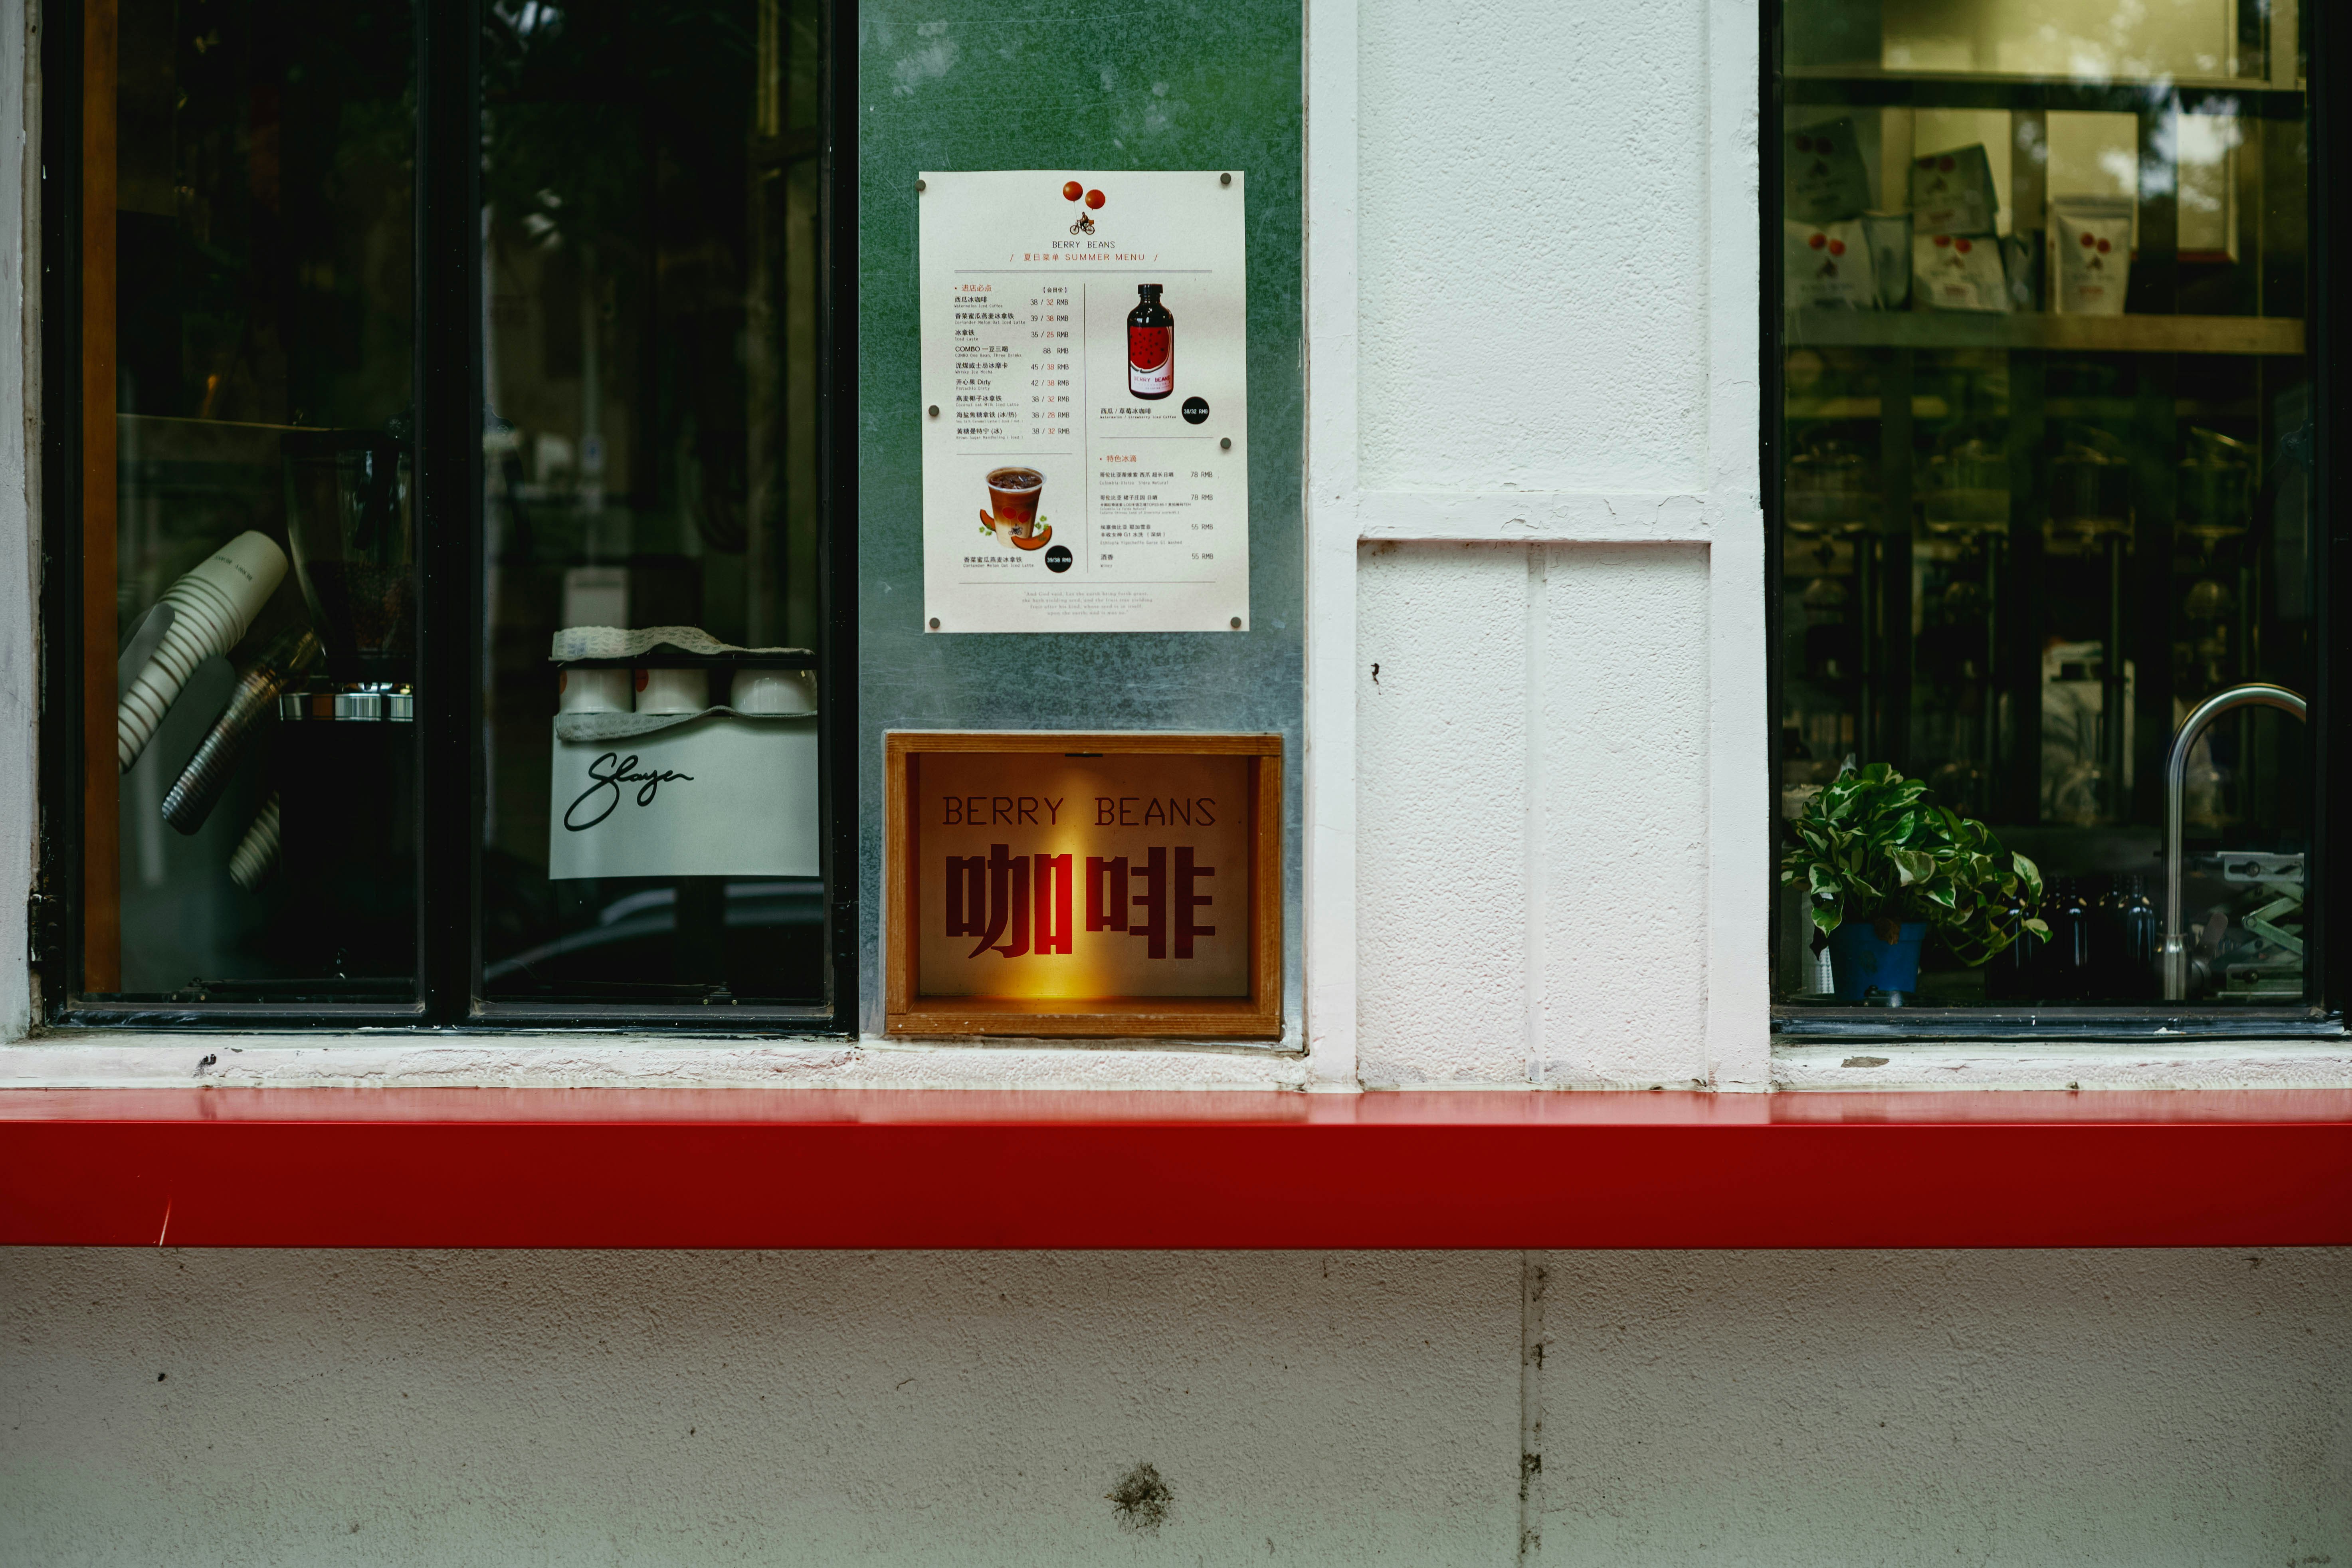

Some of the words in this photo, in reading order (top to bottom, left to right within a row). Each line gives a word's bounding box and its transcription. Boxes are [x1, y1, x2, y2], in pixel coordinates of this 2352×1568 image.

[942, 796, 1063, 826] BERRY
[1095, 797, 1216, 826] BEANS
[945, 843, 1216, 959] 咖啡
